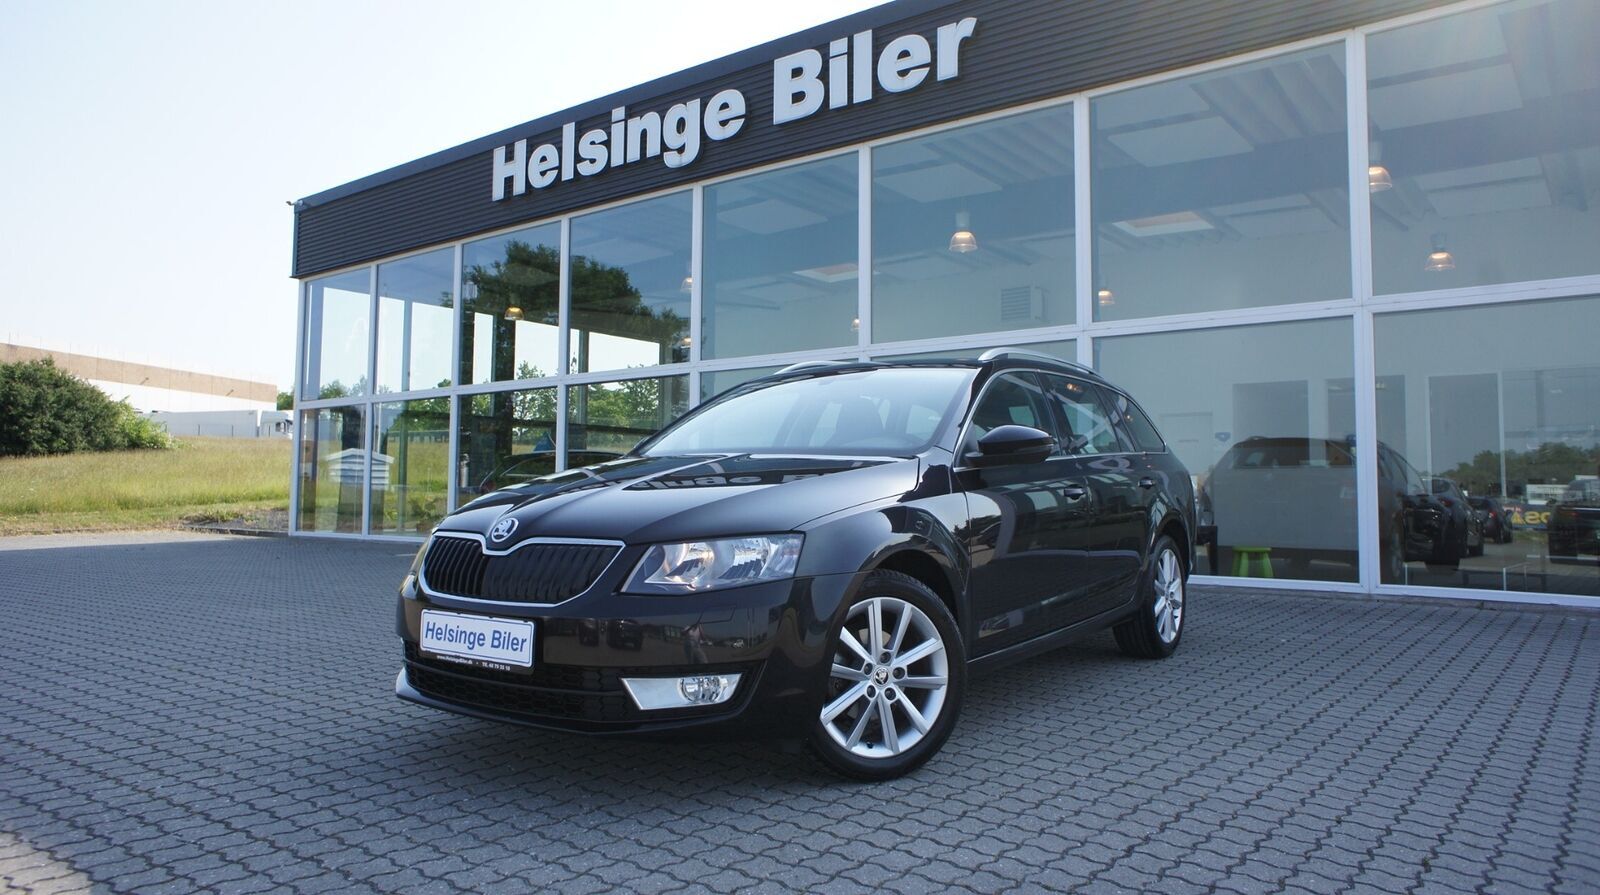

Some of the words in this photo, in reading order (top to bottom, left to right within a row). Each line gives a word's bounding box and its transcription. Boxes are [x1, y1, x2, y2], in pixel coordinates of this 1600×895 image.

[491, 88, 746, 202] Helsinge
[773, 16, 977, 125] Biler
[425, 621, 486, 650] Helsinge
[491, 630, 527, 652] Biler
